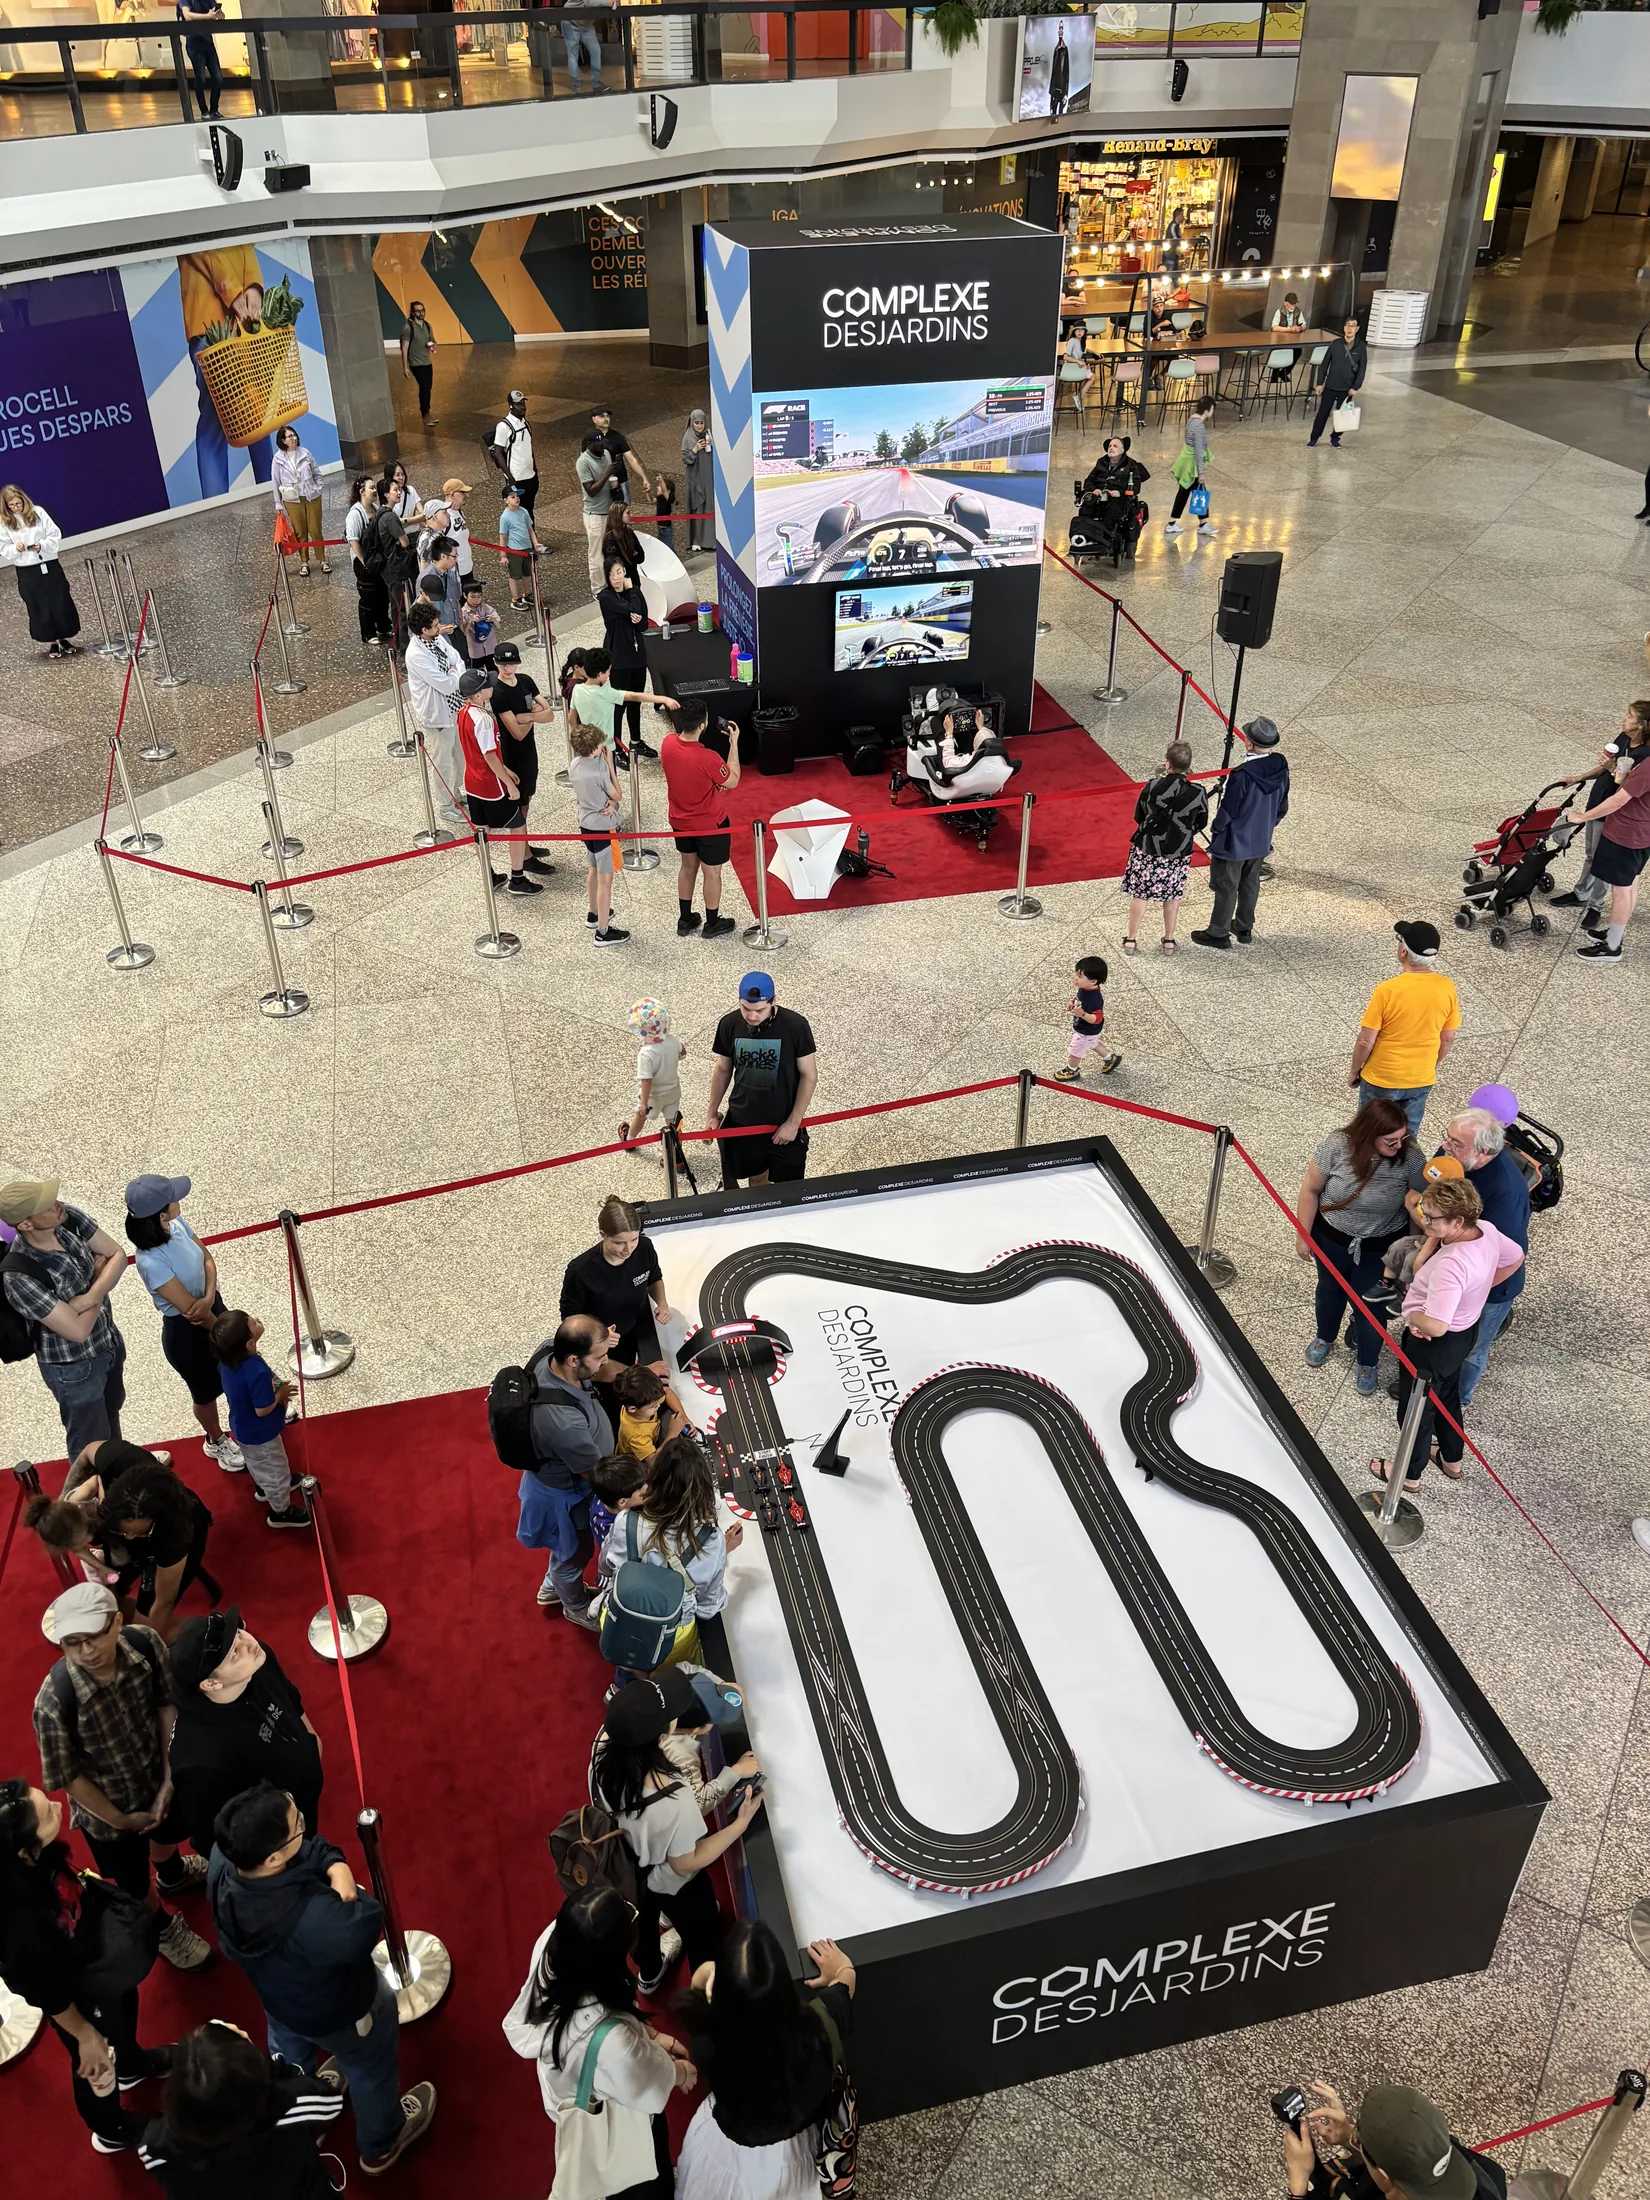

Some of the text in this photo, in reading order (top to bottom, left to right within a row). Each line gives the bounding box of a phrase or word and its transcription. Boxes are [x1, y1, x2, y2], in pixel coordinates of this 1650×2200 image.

[1102, 138, 1213, 154] Renaud-Bray
[591, 254, 646, 270] OUVER
[592, 274, 620, 289] LES
[823, 281, 990, 318] COMPLEXE
[824, 315, 988, 348] DESJARDINS
[39, 402, 132, 442] DESPARS
[898, 549, 906, 560] 7
[818, 1309, 879, 1428] DESJARDINS
[992, 1901, 1336, 2010] COMPLEXE
[991, 1938, 1326, 2045] DESJARDINS
